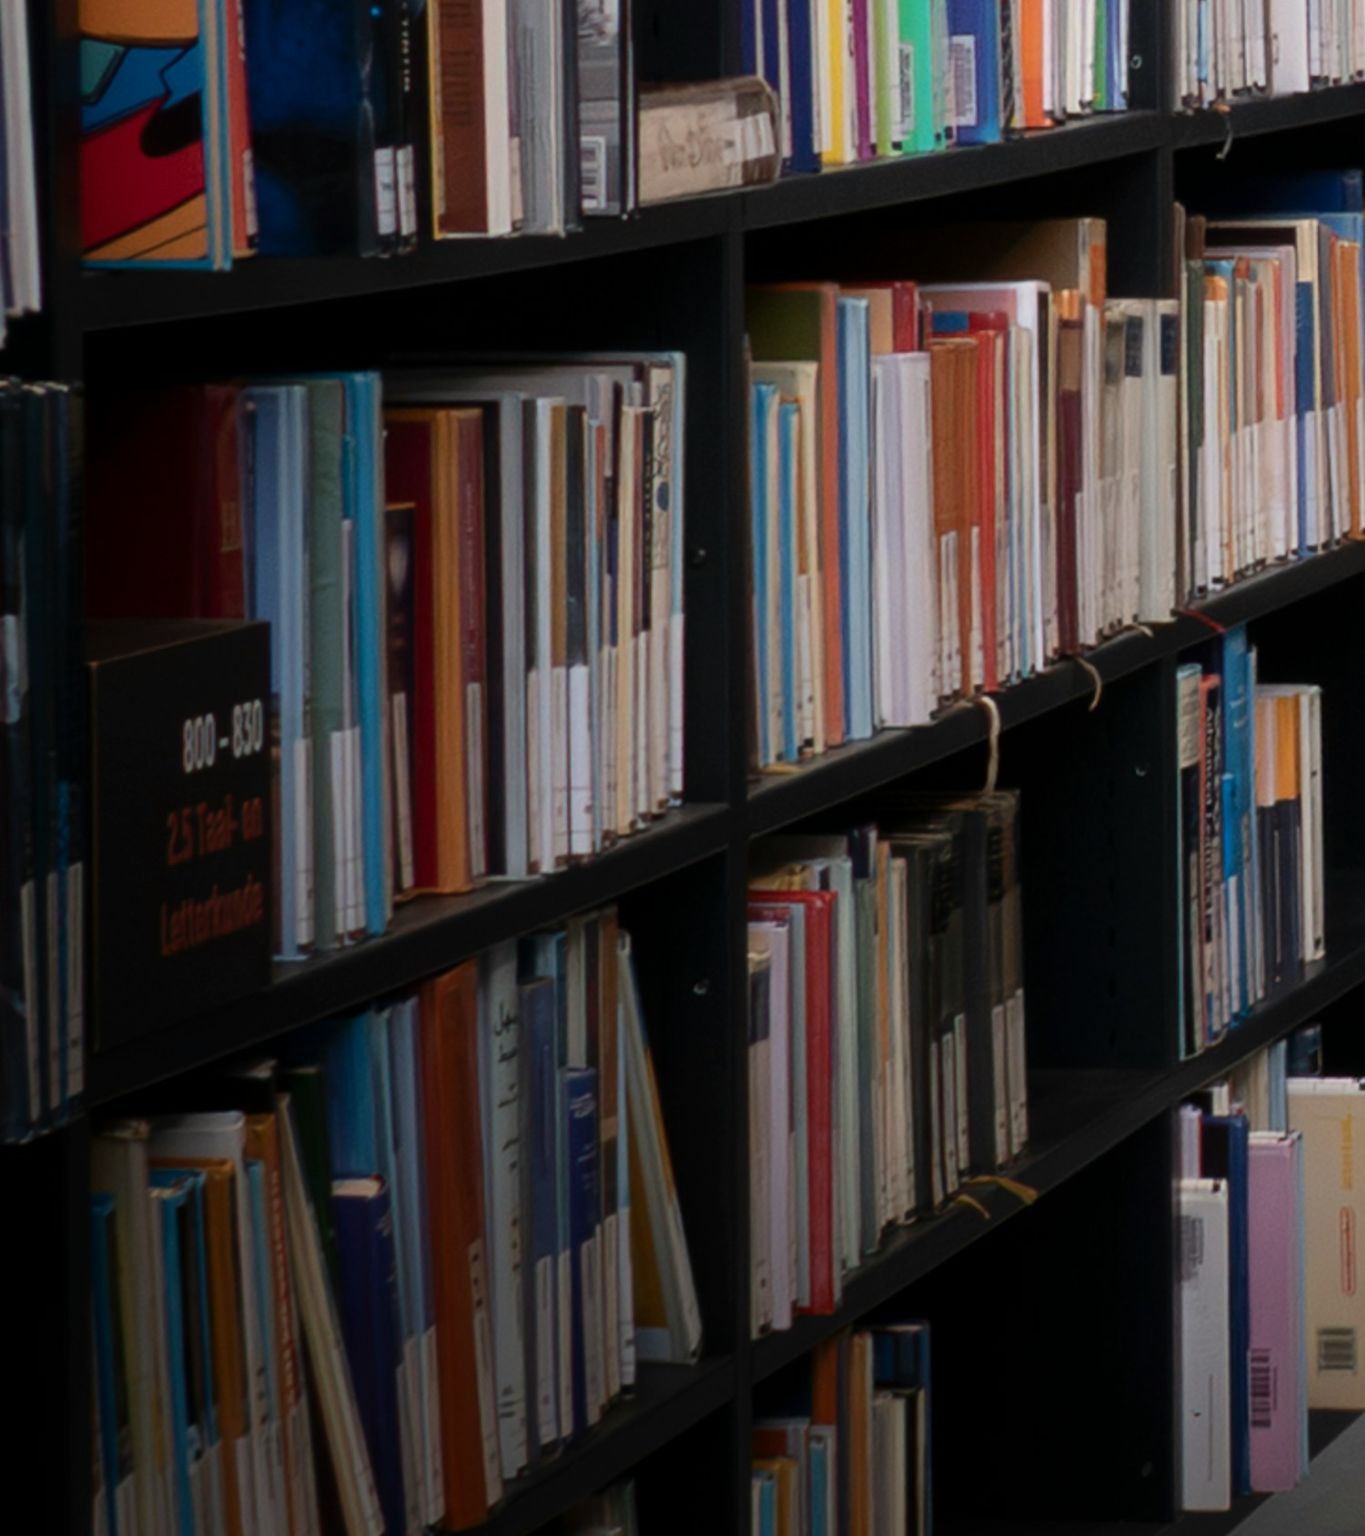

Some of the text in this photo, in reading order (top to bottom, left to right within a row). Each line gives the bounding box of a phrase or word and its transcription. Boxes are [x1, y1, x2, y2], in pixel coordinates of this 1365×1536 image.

[182, 713, 215, 773] 800
[242, 797, 263, 841] en
[162, 873, 263, 957] Letterkunde
